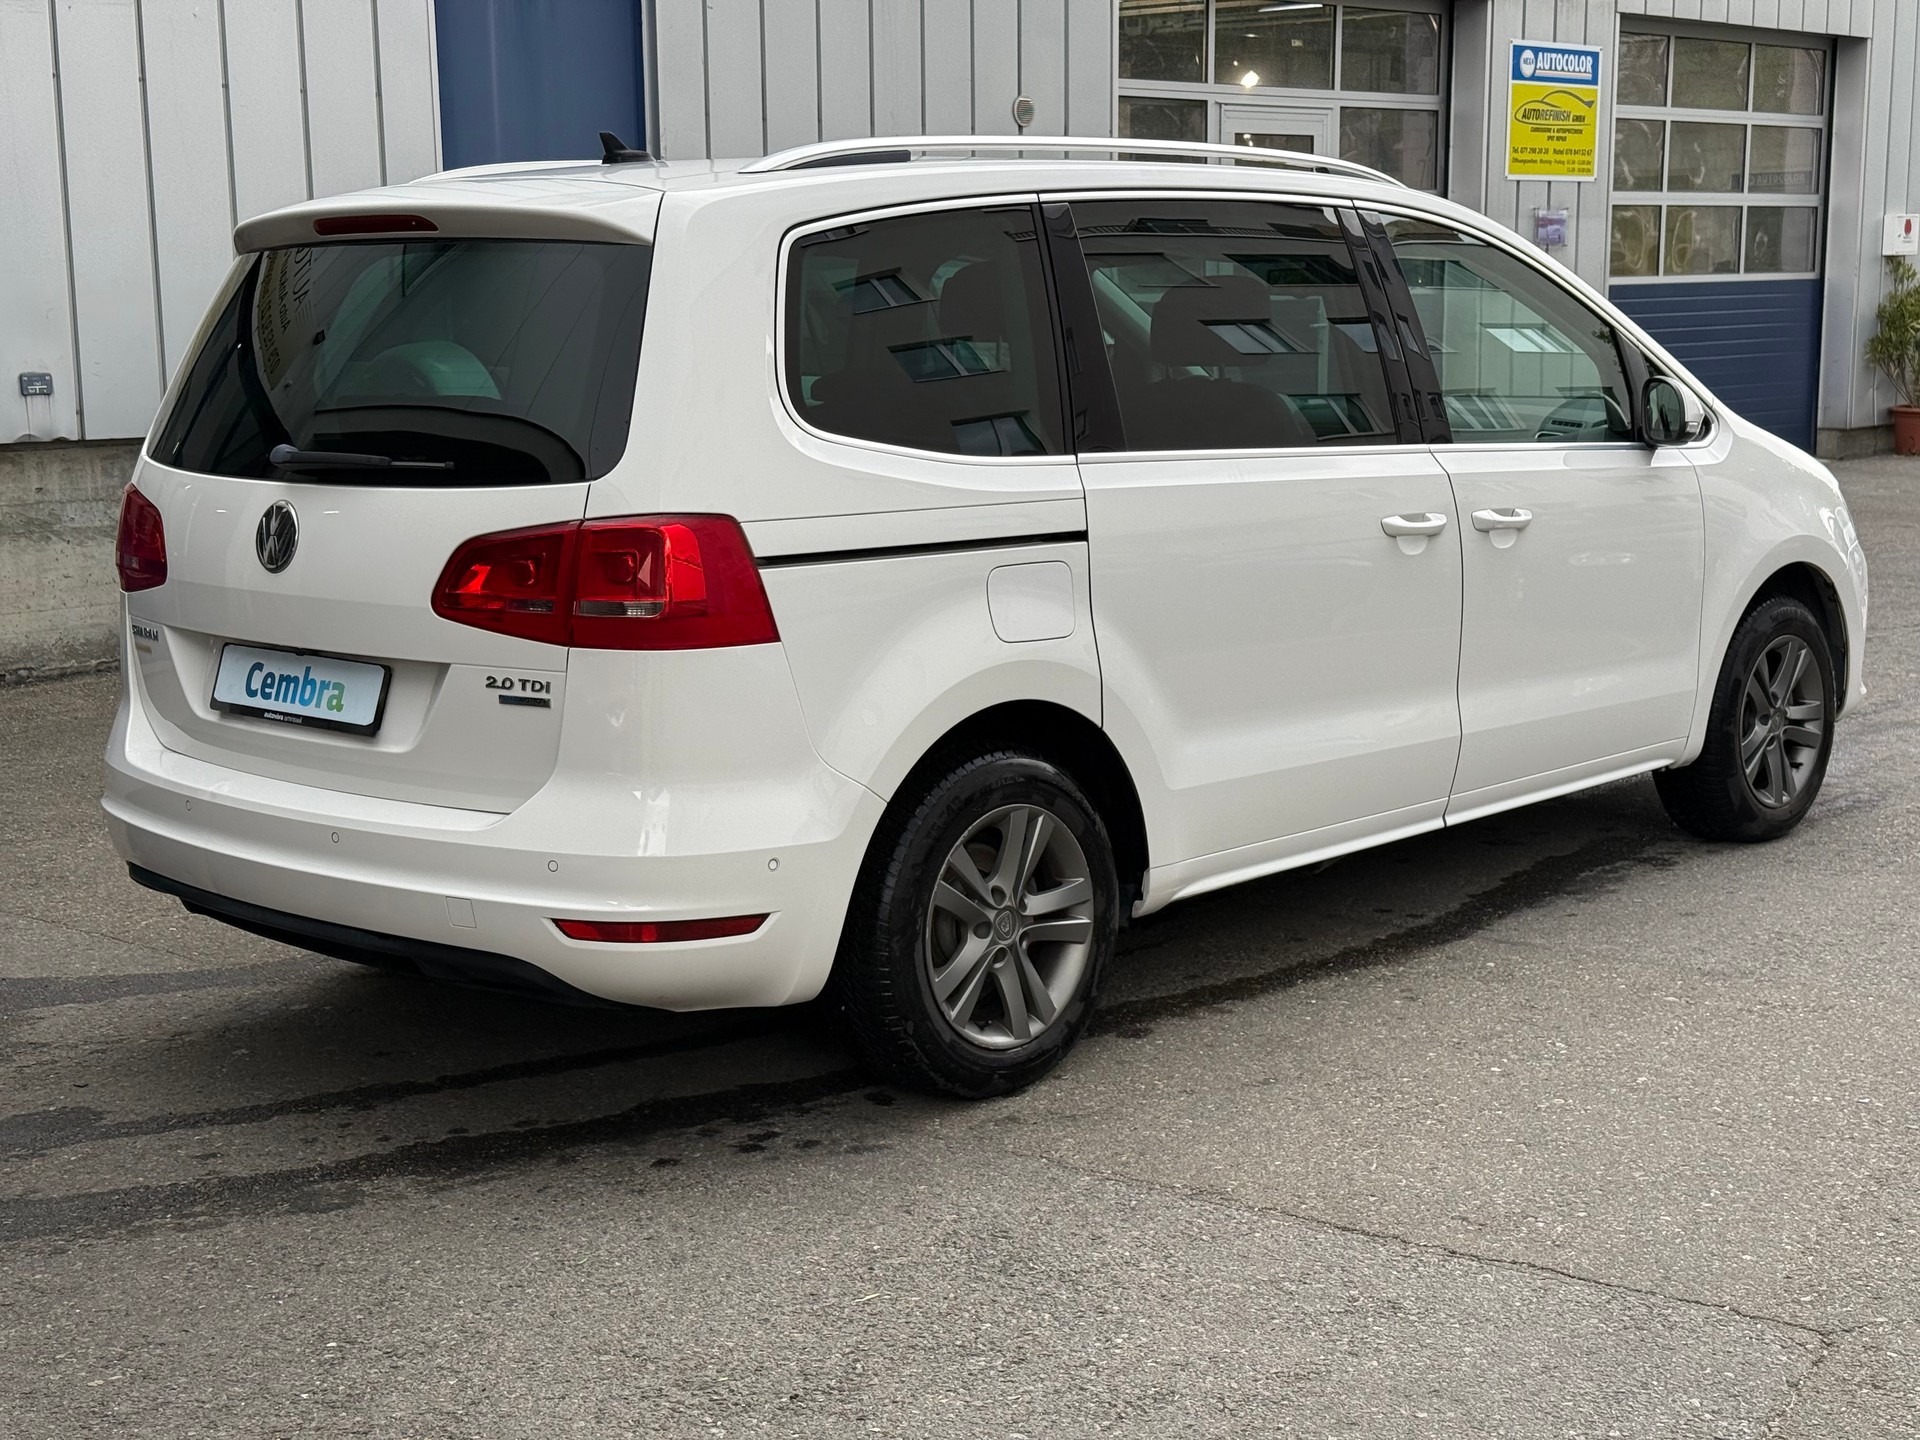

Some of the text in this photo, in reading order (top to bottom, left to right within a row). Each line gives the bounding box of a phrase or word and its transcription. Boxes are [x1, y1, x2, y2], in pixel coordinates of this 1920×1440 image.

[1536, 51, 1593, 73] AUTOCOLOR
[1521, 107, 1571, 122] AUTOREFINISH
[245, 661, 346, 713] Cembra
[485, 675, 551, 694] 2.0 TDI
